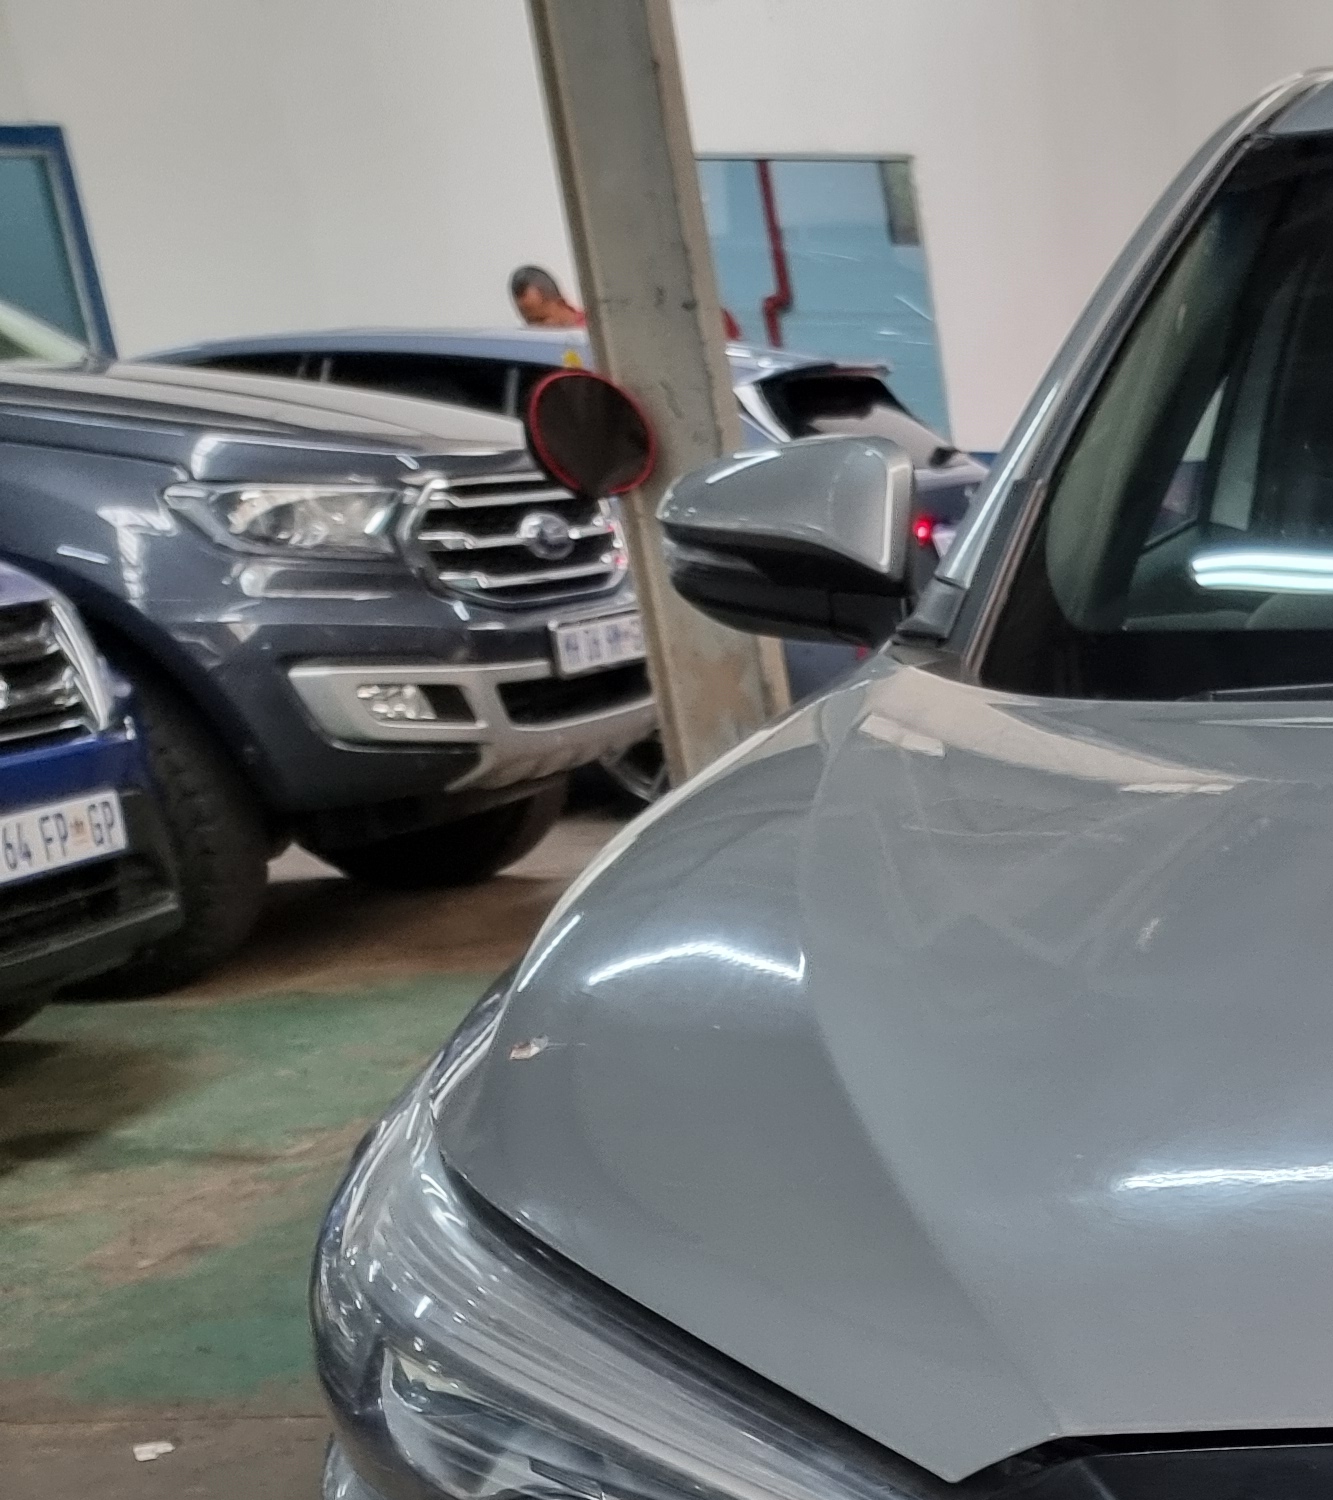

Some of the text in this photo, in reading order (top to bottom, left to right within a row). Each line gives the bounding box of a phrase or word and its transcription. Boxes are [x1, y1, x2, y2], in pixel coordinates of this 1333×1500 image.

[1, 800, 115, 870] 64 FP GP
